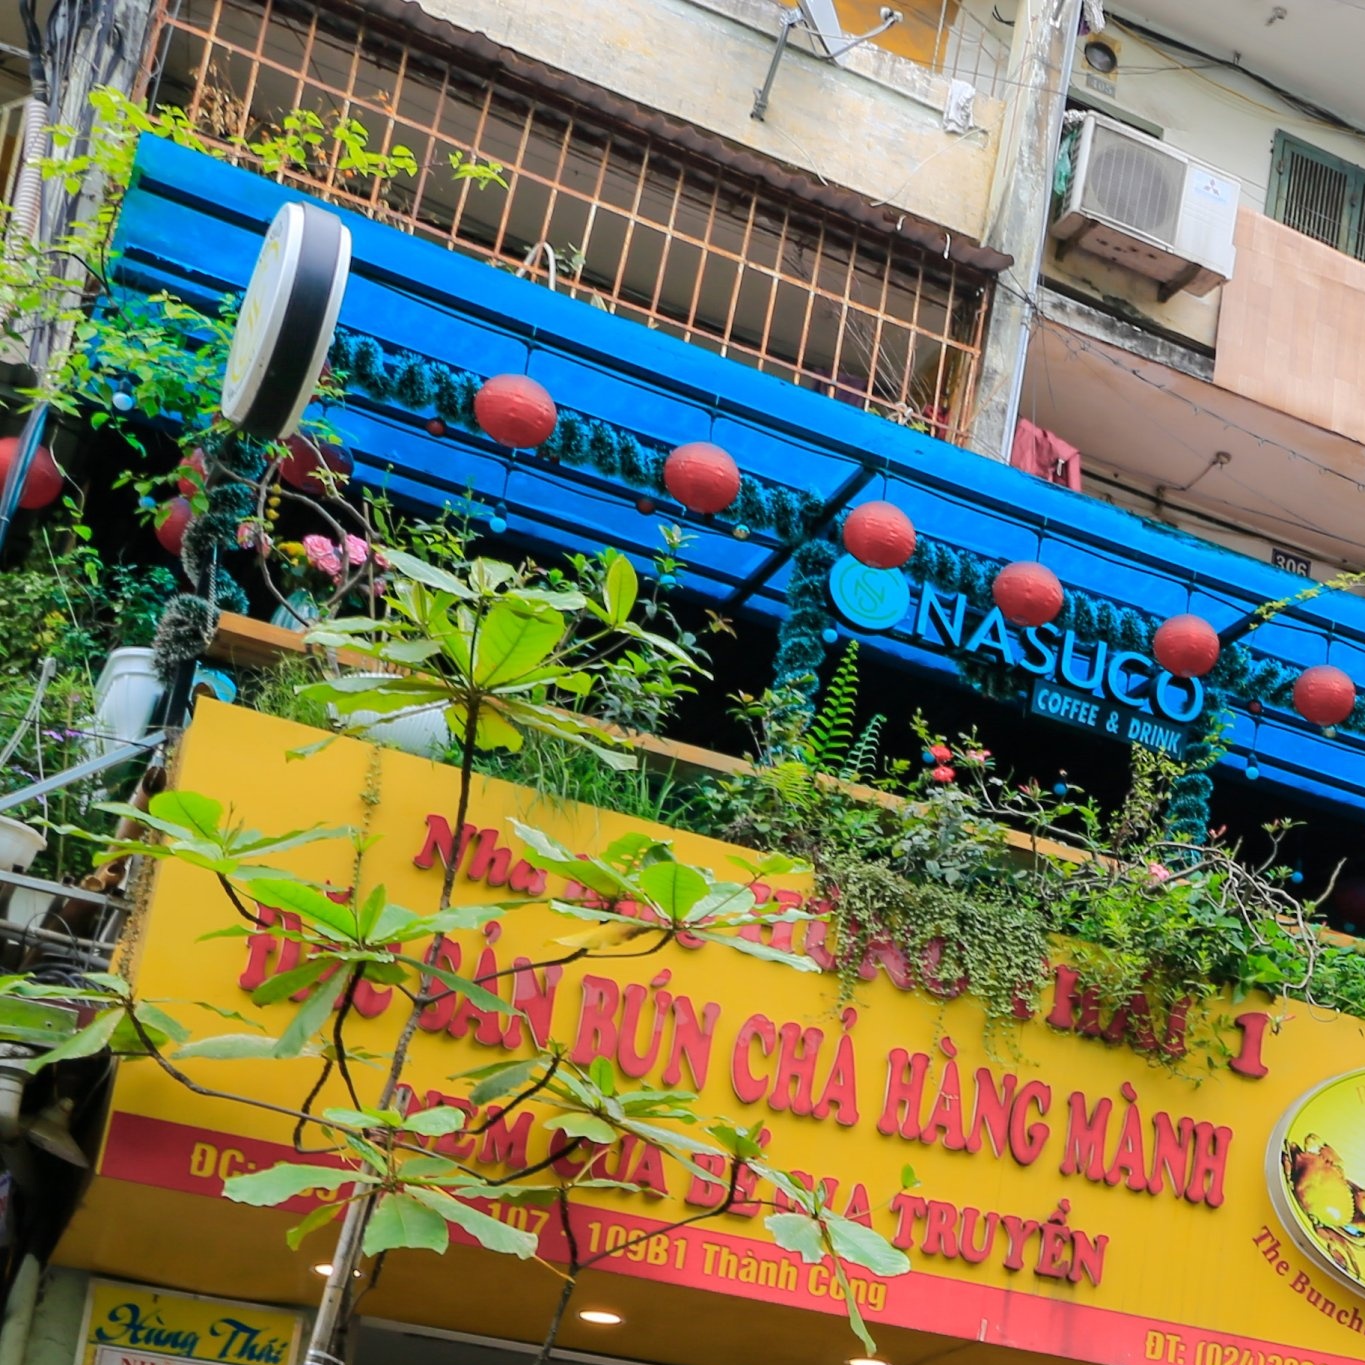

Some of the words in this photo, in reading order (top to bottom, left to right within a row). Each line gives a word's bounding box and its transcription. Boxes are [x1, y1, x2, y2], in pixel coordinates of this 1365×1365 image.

[915, 580, 1201, 722] NASUCO
[1036, 687, 1097, 727] COFFEE
[1105, 711, 1120, 734] &
[1126, 716, 1184, 755] DRINK
[571, 967, 722, 1090] BÚN
[730, 1005, 859, 1127] CHẢ
[876, 1036, 1051, 1168] HÀNG
[1060, 1081, 1234, 1208] MÀNH
[587, 1221, 688, 1270] 109B1
[701, 1241, 799, 1293] Thành
[806, 1263, 888, 1312] Công
[890, 1198, 1110, 1286] TRUYỀN
[1251, 1224, 1291, 1278] The
[208, 1317, 291, 1365] Thái
[1143, 1329, 1186, 1365] ĐT:
